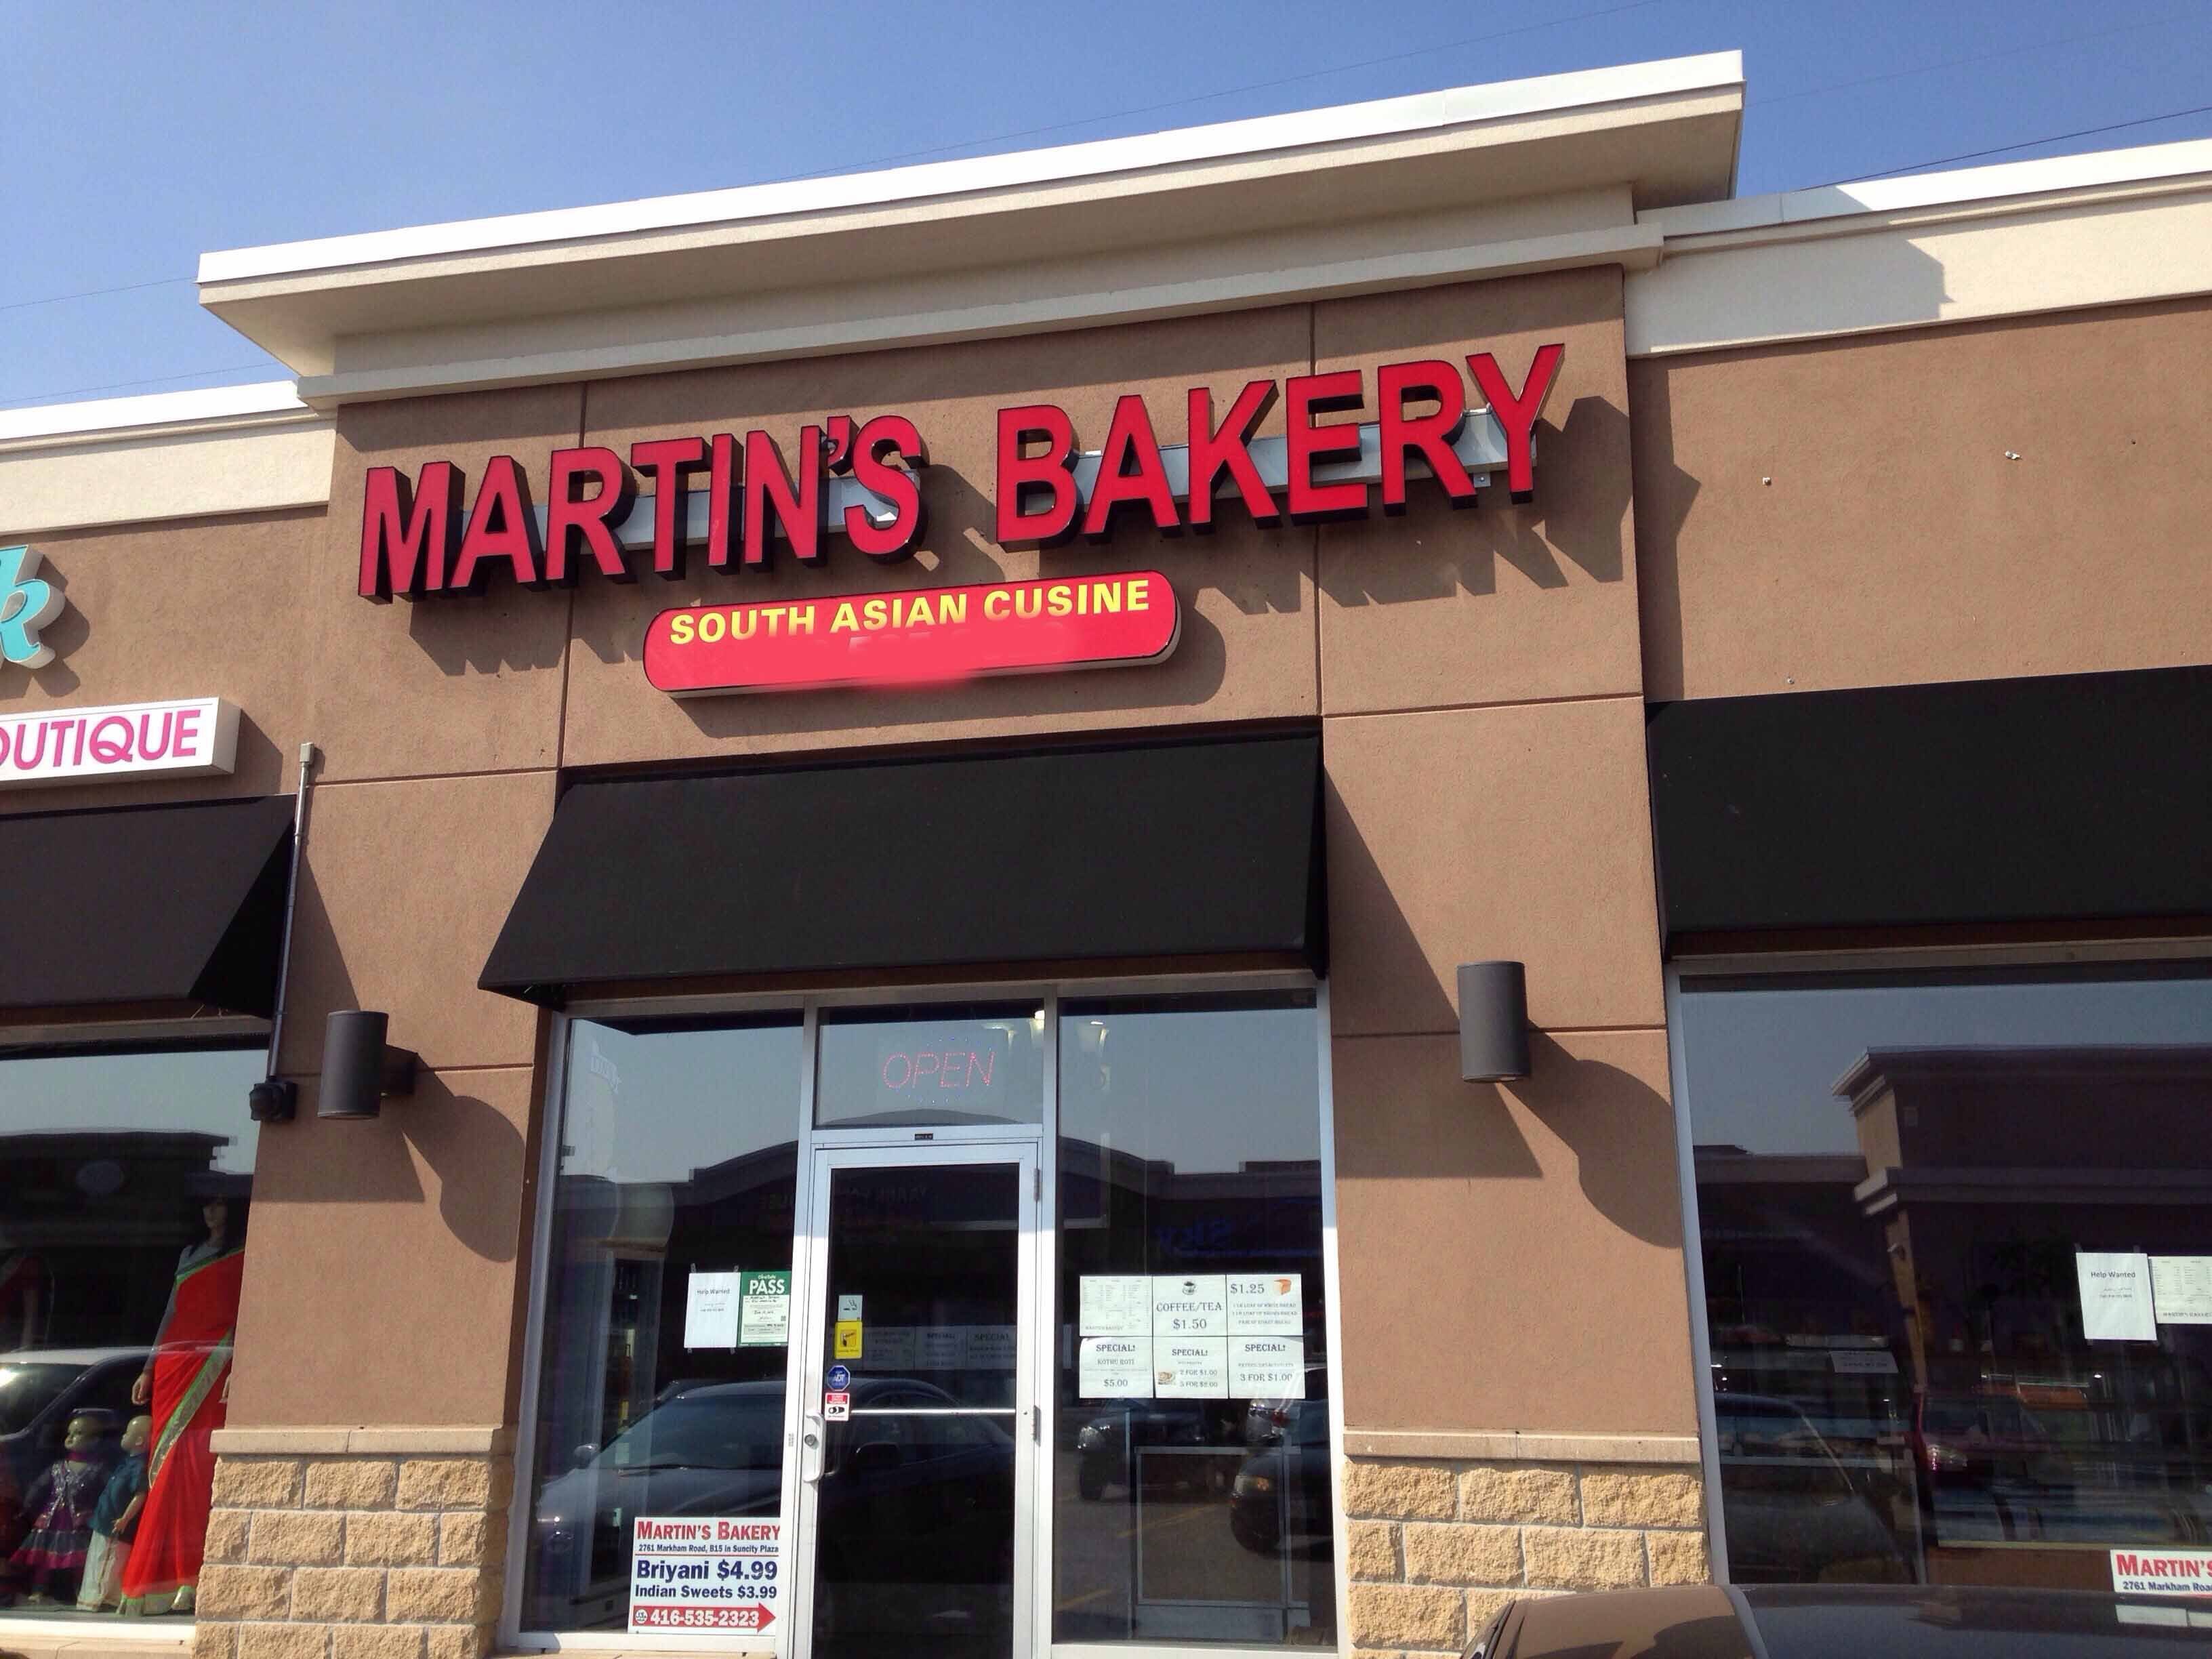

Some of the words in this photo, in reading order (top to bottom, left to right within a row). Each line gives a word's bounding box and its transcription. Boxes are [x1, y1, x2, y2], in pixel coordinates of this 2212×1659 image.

[359, 415, 923, 596] MARTIN'S
[996, 344, 1565, 543] BAKERY
[670, 605, 815, 645] SOUTH
[829, 593, 967, 634] ASIAN
[983, 579, 1151, 619] CUSINE
[0, 710, 201, 770] UTIQUE
[883, 1051, 995, 1088] OPEN
[749, 1279, 785, 1294] PASS
[1230, 1283, 1265, 1294] $1.25
[1156, 1302, 1222, 1312] COFFEE/TEA
[1173, 1318, 1207, 1330] $1.50
[1096, 1344, 1136, 1352] SPECIAL!
[1248, 1374, 1265, 1382] FOR
[637, 1521, 711, 1540] MARTIN'S
[718, 1521, 779, 1540] BAKERY
[689, 1545, 708, 1553] Road,
[733, 1545, 758, 1553] Suncity
[637, 1560, 709, 1583] Briyani
[717, 1559, 777, 1580] $4.99
[635, 1585, 676, 1597] Indian
[681, 1585, 733, 1599] Sweets
[737, 1585, 777, 1599] $3.99
[2123, 1581, 2145, 1590] 2761
[2148, 1582, 2190, 1591] Markham
[650, 1609, 760, 1626] 416-535-2323
